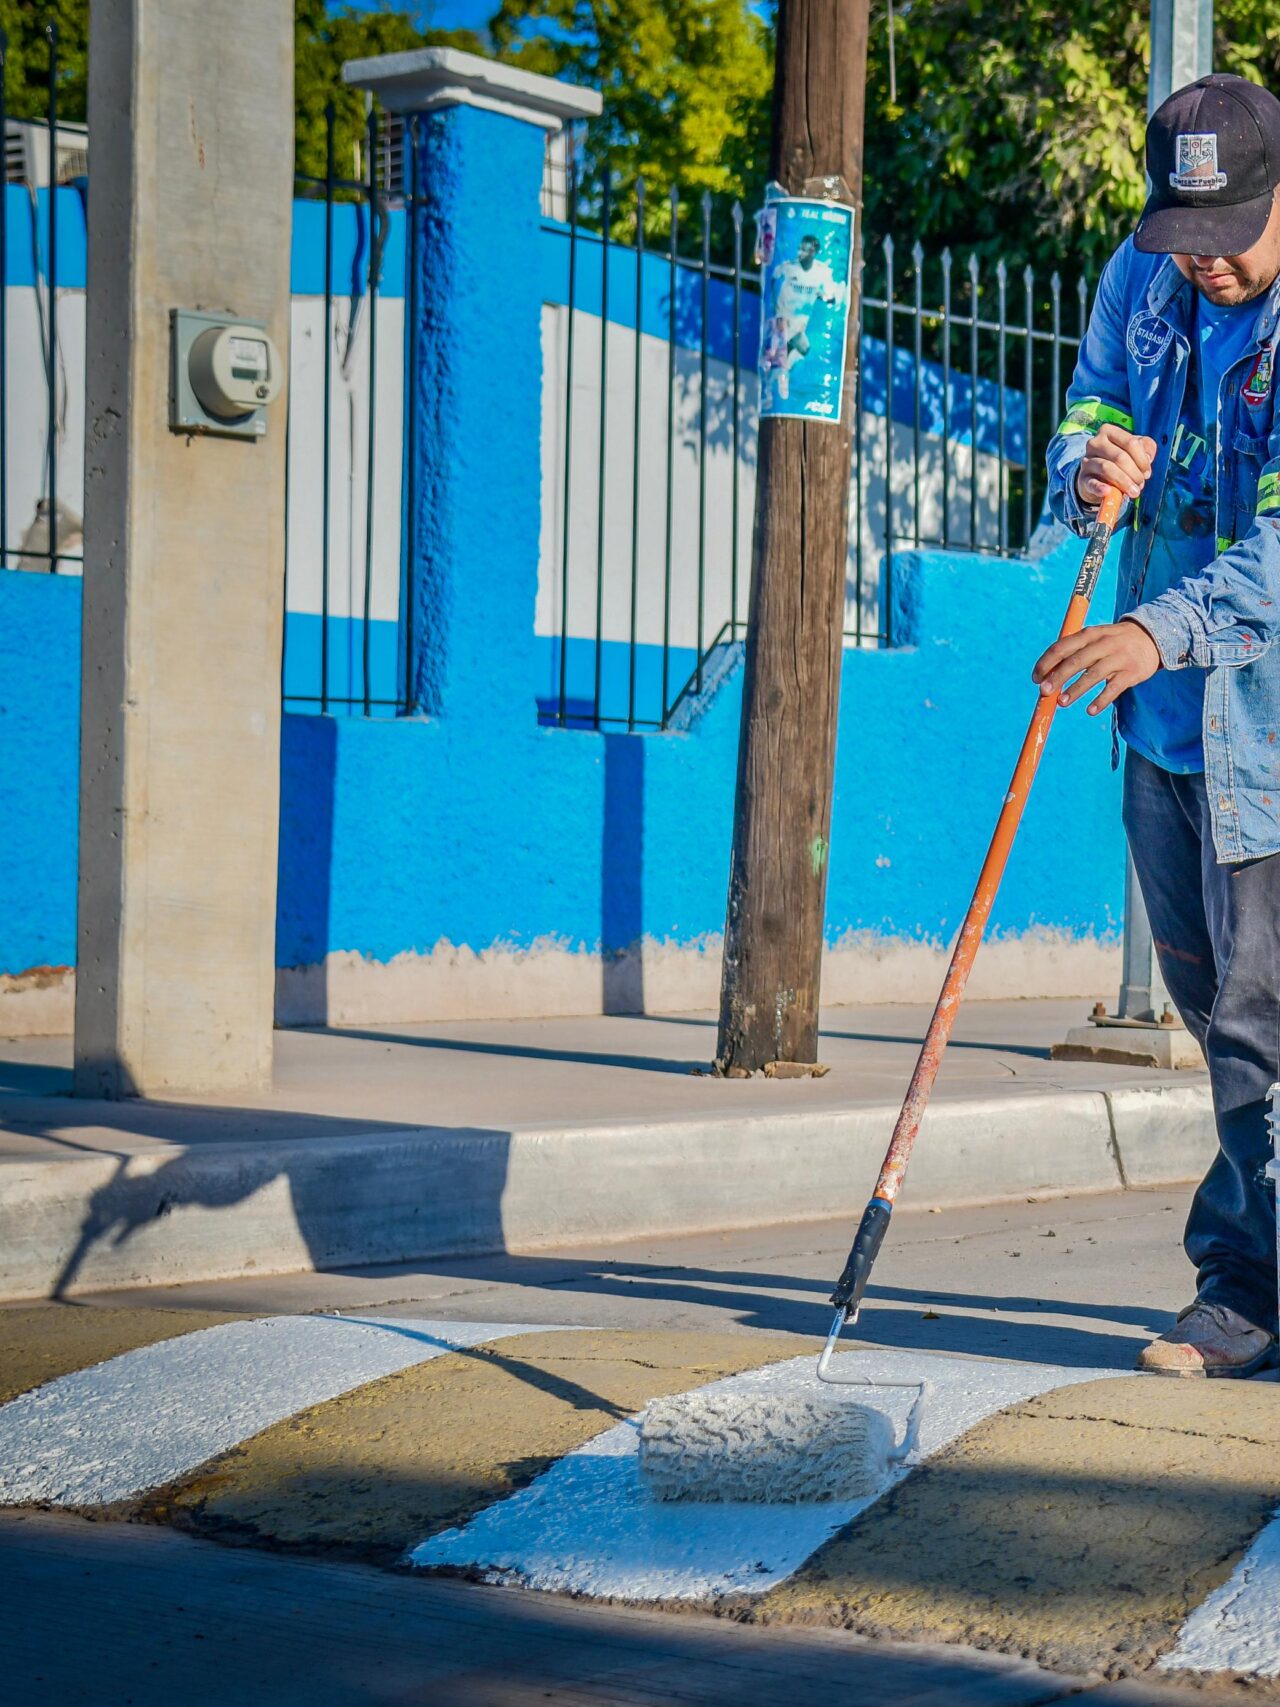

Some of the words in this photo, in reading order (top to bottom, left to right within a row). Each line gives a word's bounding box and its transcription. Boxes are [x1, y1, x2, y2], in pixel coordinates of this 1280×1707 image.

[1173, 177, 1192, 185] Cerca
[1198, 176, 1223, 185] Pueblo
[1136, 327, 1165, 345] STASASA
[1074, 554, 1095, 596] TRUPER
